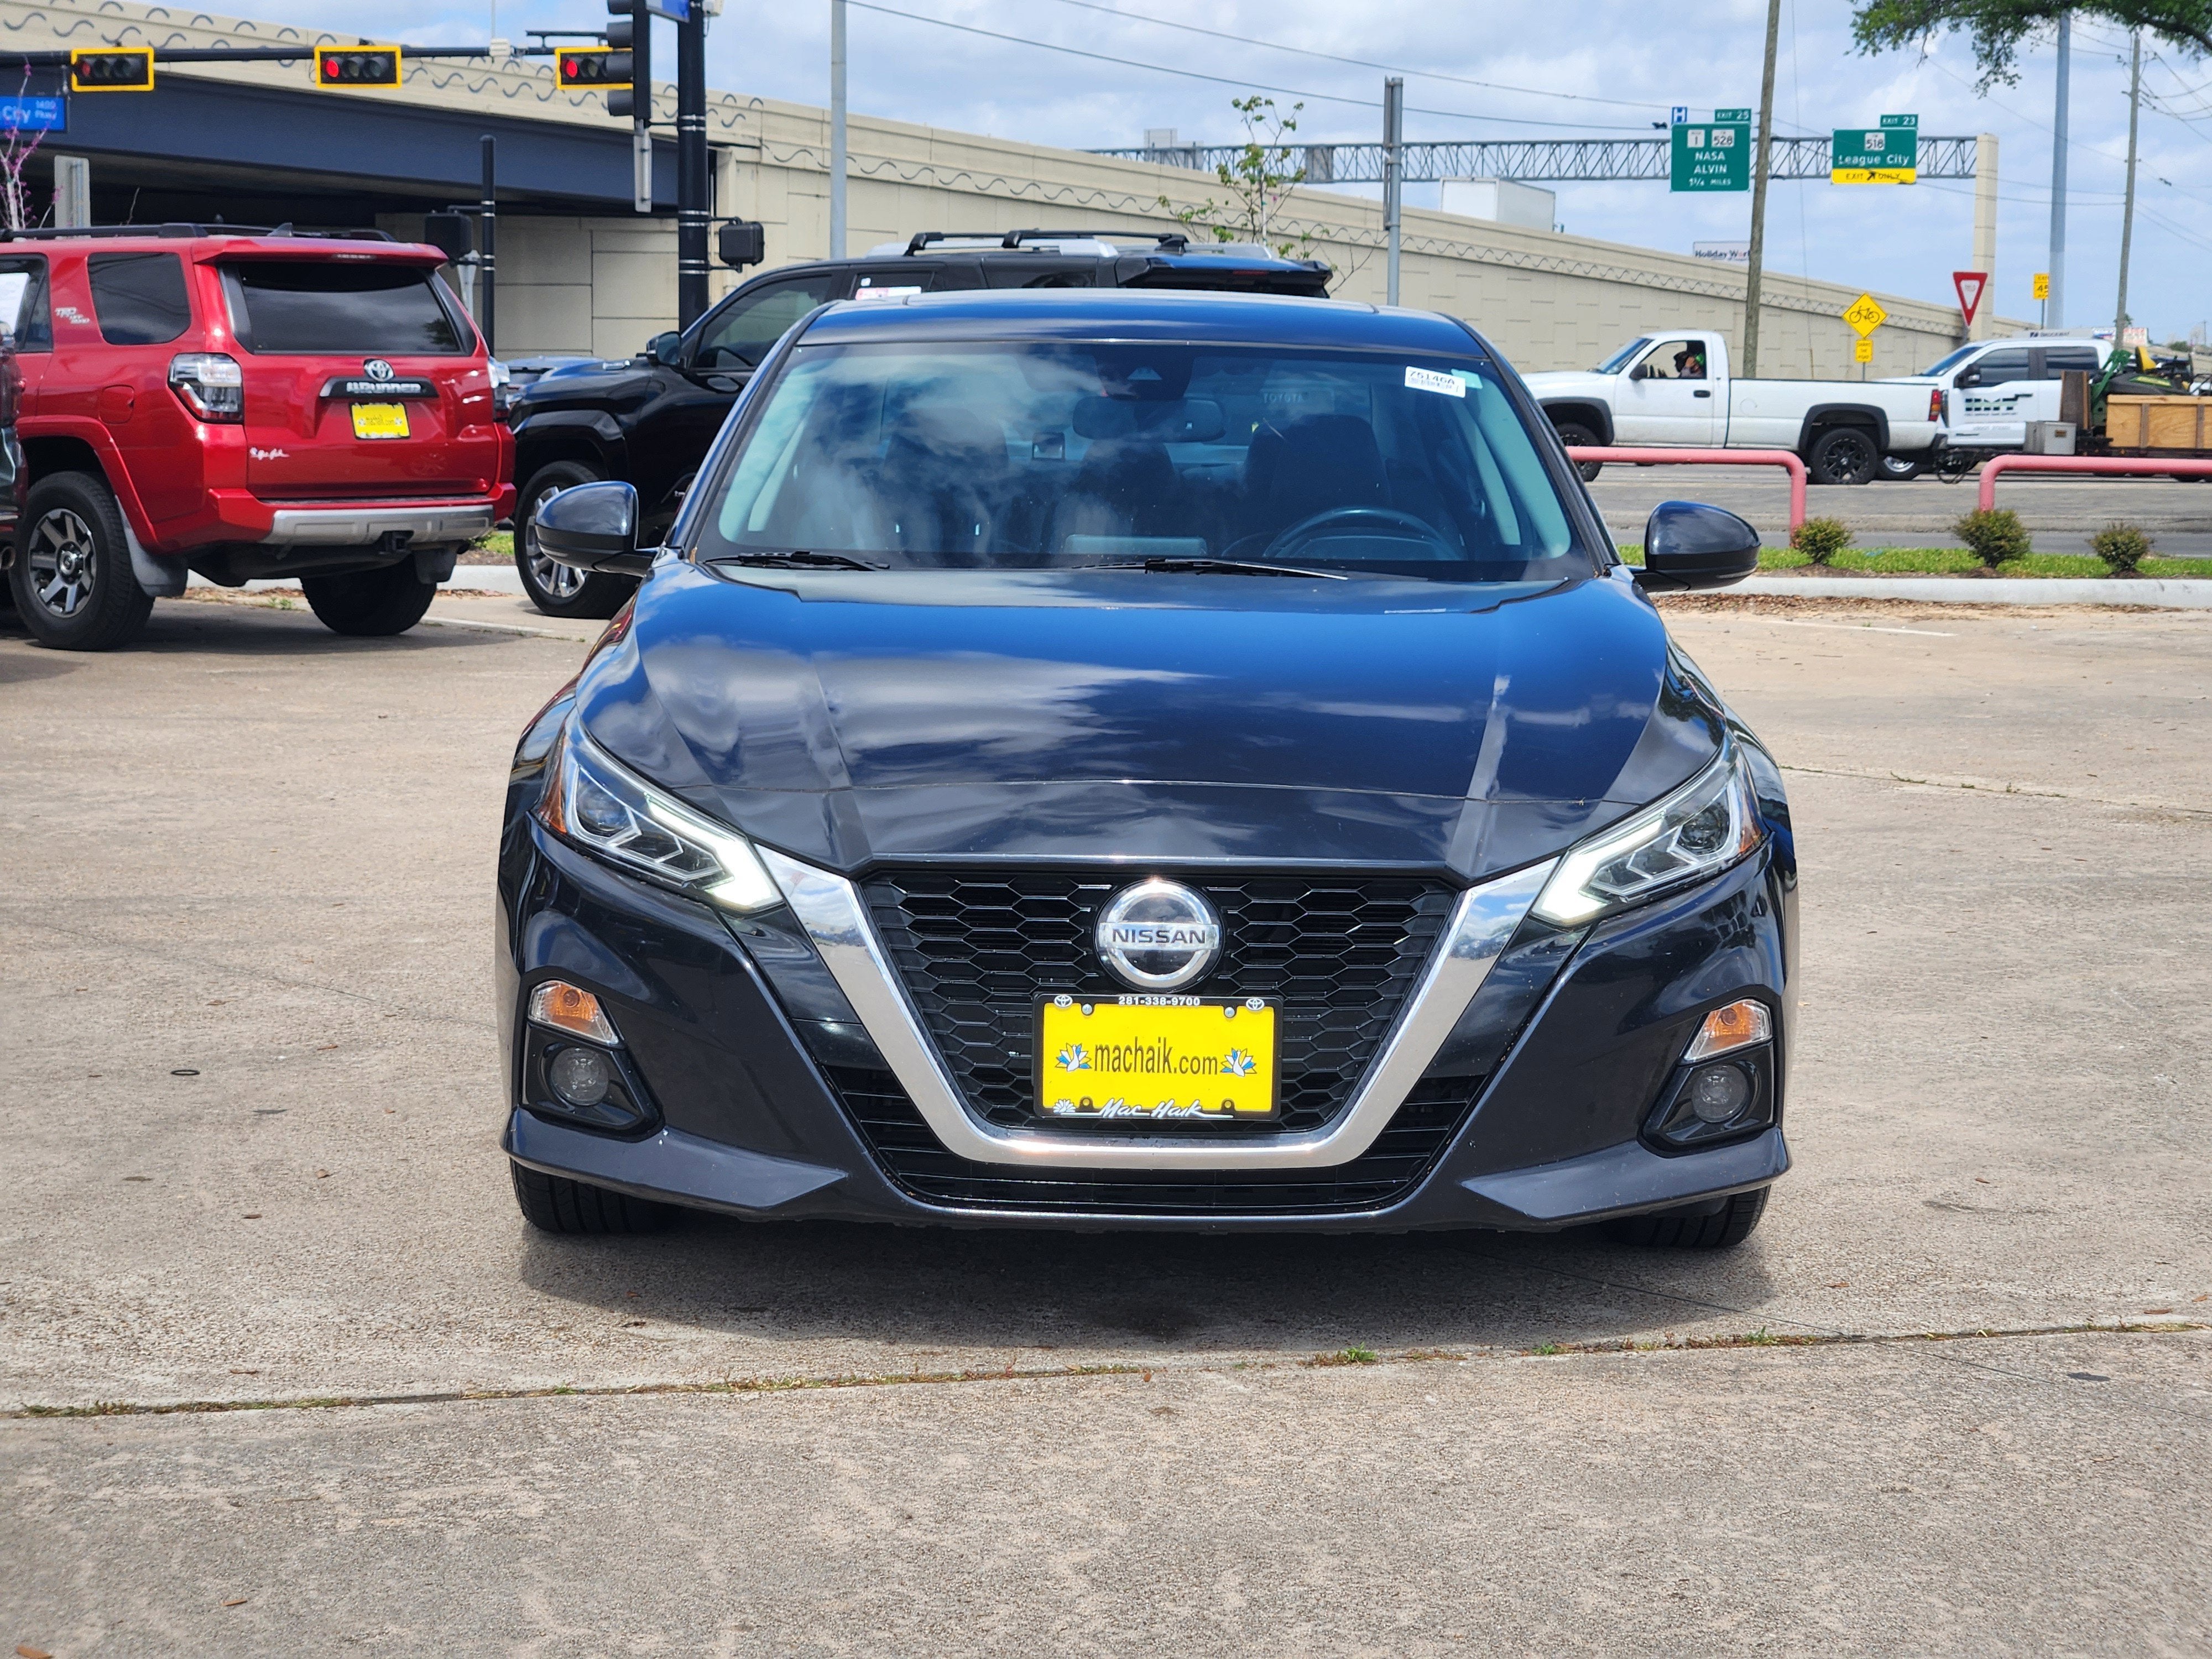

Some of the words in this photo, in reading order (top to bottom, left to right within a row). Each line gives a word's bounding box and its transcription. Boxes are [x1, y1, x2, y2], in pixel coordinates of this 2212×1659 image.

[1673, 108, 1686, 122] H
[1737, 111, 1749, 119] 25
[1902, 116, 1916, 126] 23
[1714, 135, 1733, 145] 528
[1866, 139, 1884, 149] 518
[1695, 151, 1726, 161] NASA
[1838, 155, 1881, 166] League
[1886, 153, 1910, 165] City
[1693, 164, 1728, 174] ALVIN
[1112, 929, 1206, 945] NISSAN
[1118, 996, 1201, 1006] 281-338-9700
[1094, 1036, 1218, 1075] machaik.com
[1098, 1098, 1147, 1118] Mac
